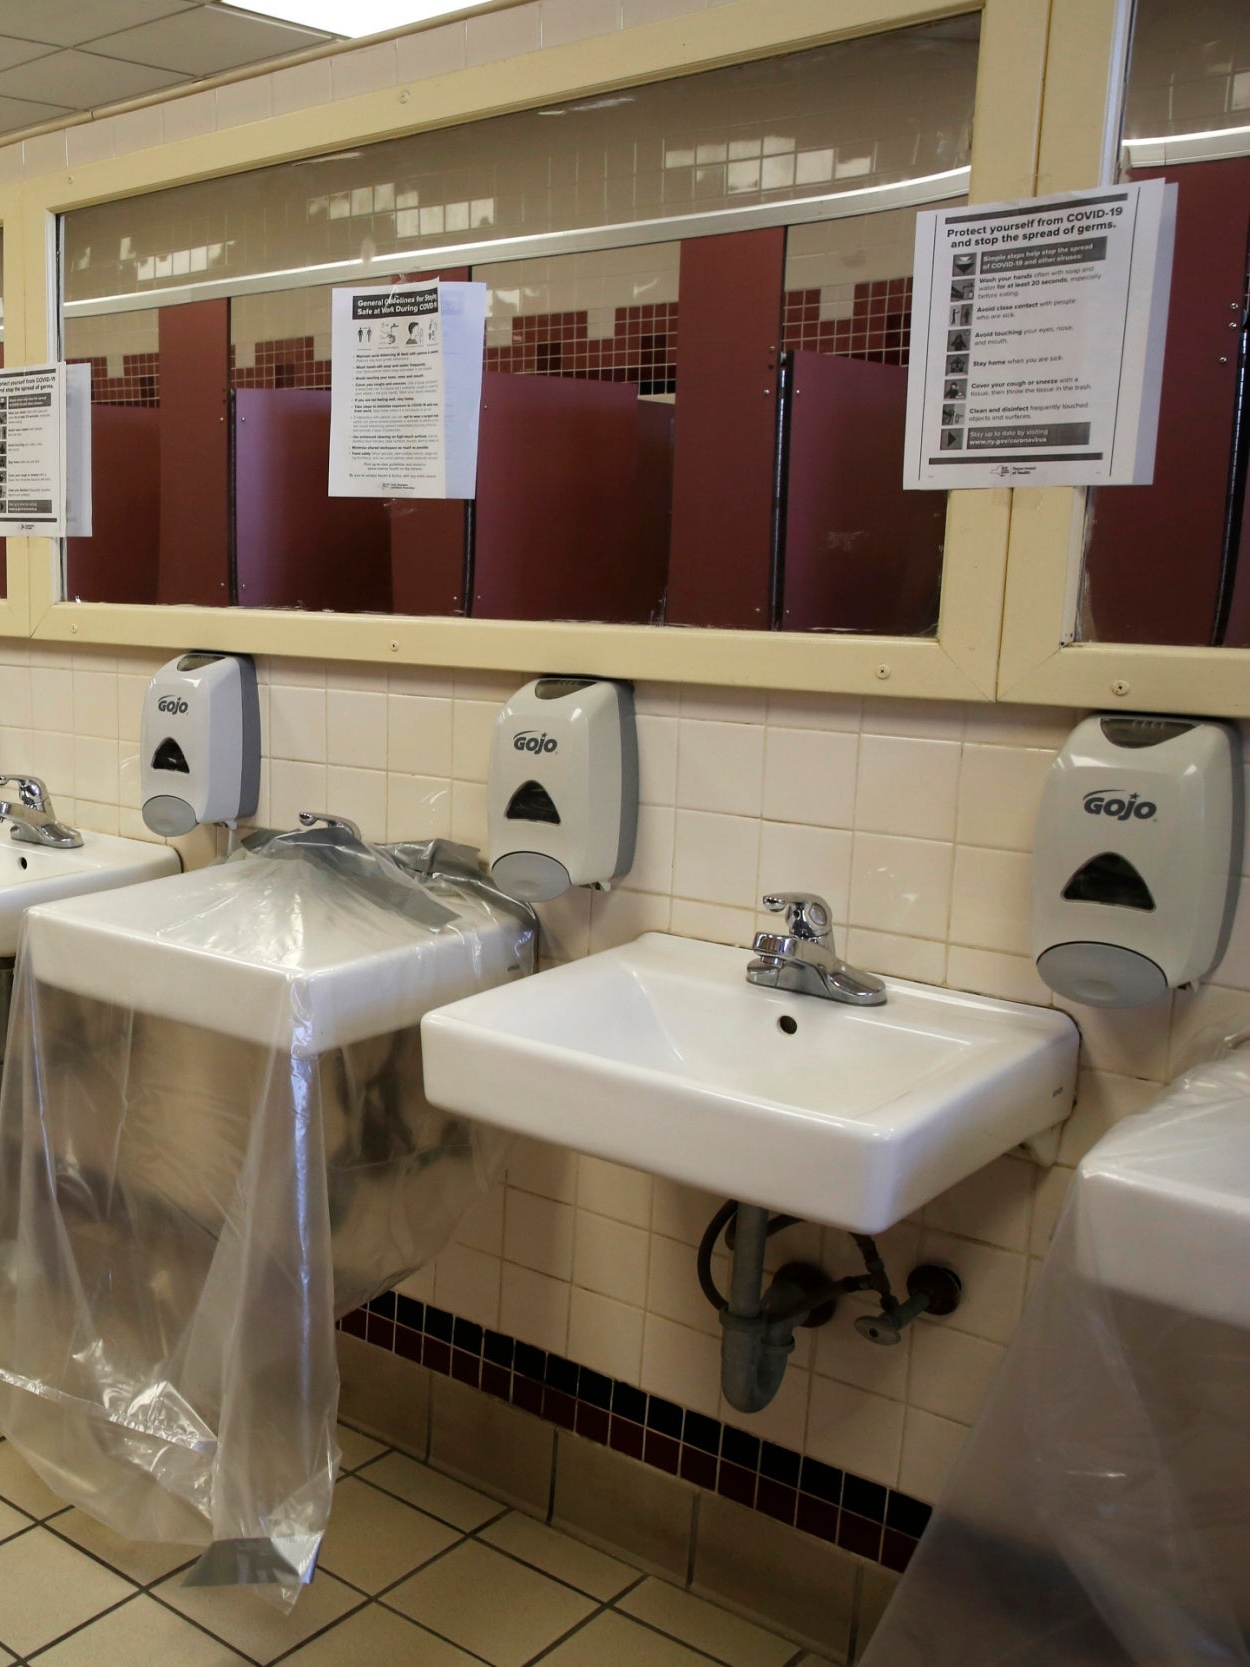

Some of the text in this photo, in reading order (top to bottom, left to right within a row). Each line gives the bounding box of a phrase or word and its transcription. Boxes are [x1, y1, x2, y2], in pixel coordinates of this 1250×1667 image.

[947, 206, 1123, 238] Protect yourself from COVID-19
[951, 222, 1116, 248] and stop the spread of germs.
[983, 254, 1006, 262] Simple
[1026, 250, 1040, 258] help
[1070, 243, 1094, 252] spread
[991, 260, 1023, 269] COVID-19
[1038, 256, 1055, 264] other
[1070, 273, 1102, 282] especially
[358, 299, 383, 307] General
[1054, 298, 1076, 306] people
[382, 306, 395, 314] Work
[396, 305, 418, 313] During
[994, 329, 1023, 337] touching
